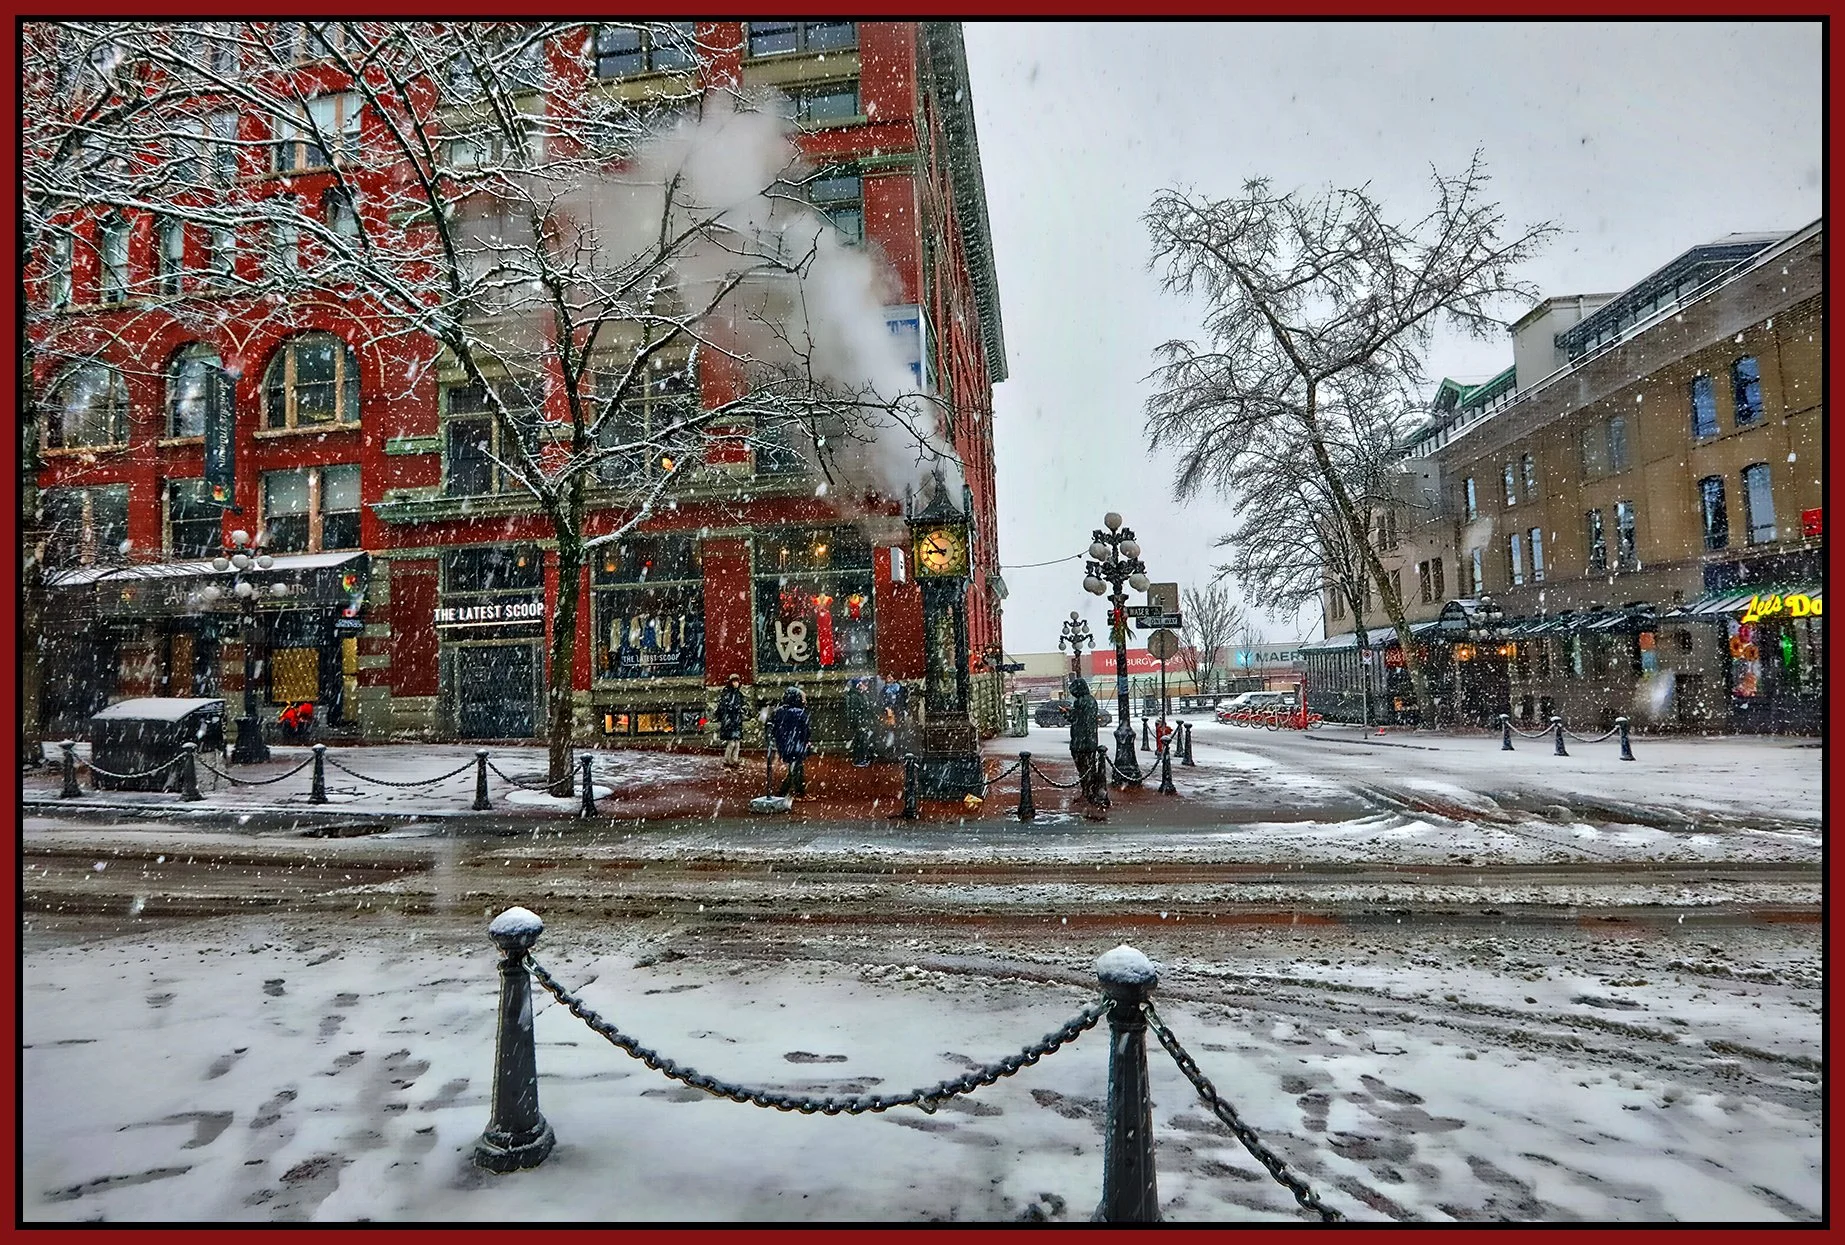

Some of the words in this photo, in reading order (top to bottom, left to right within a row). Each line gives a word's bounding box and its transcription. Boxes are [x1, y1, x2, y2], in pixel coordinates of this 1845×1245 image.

[434, 609, 456, 622] THE
[459, 604, 502, 621] LATEST
[506, 602, 545, 618] SCOOP
[1741, 594, 1783, 624] Lee's
[1164, 617, 1178, 625] WAY
[623, 655, 635, 663] THE
[636, 654, 657, 663] LATEST
[659, 653, 679, 662] SCOOP
[1256, 651, 1304, 662] MAER
[1105, 657, 1149, 667] HABURG
